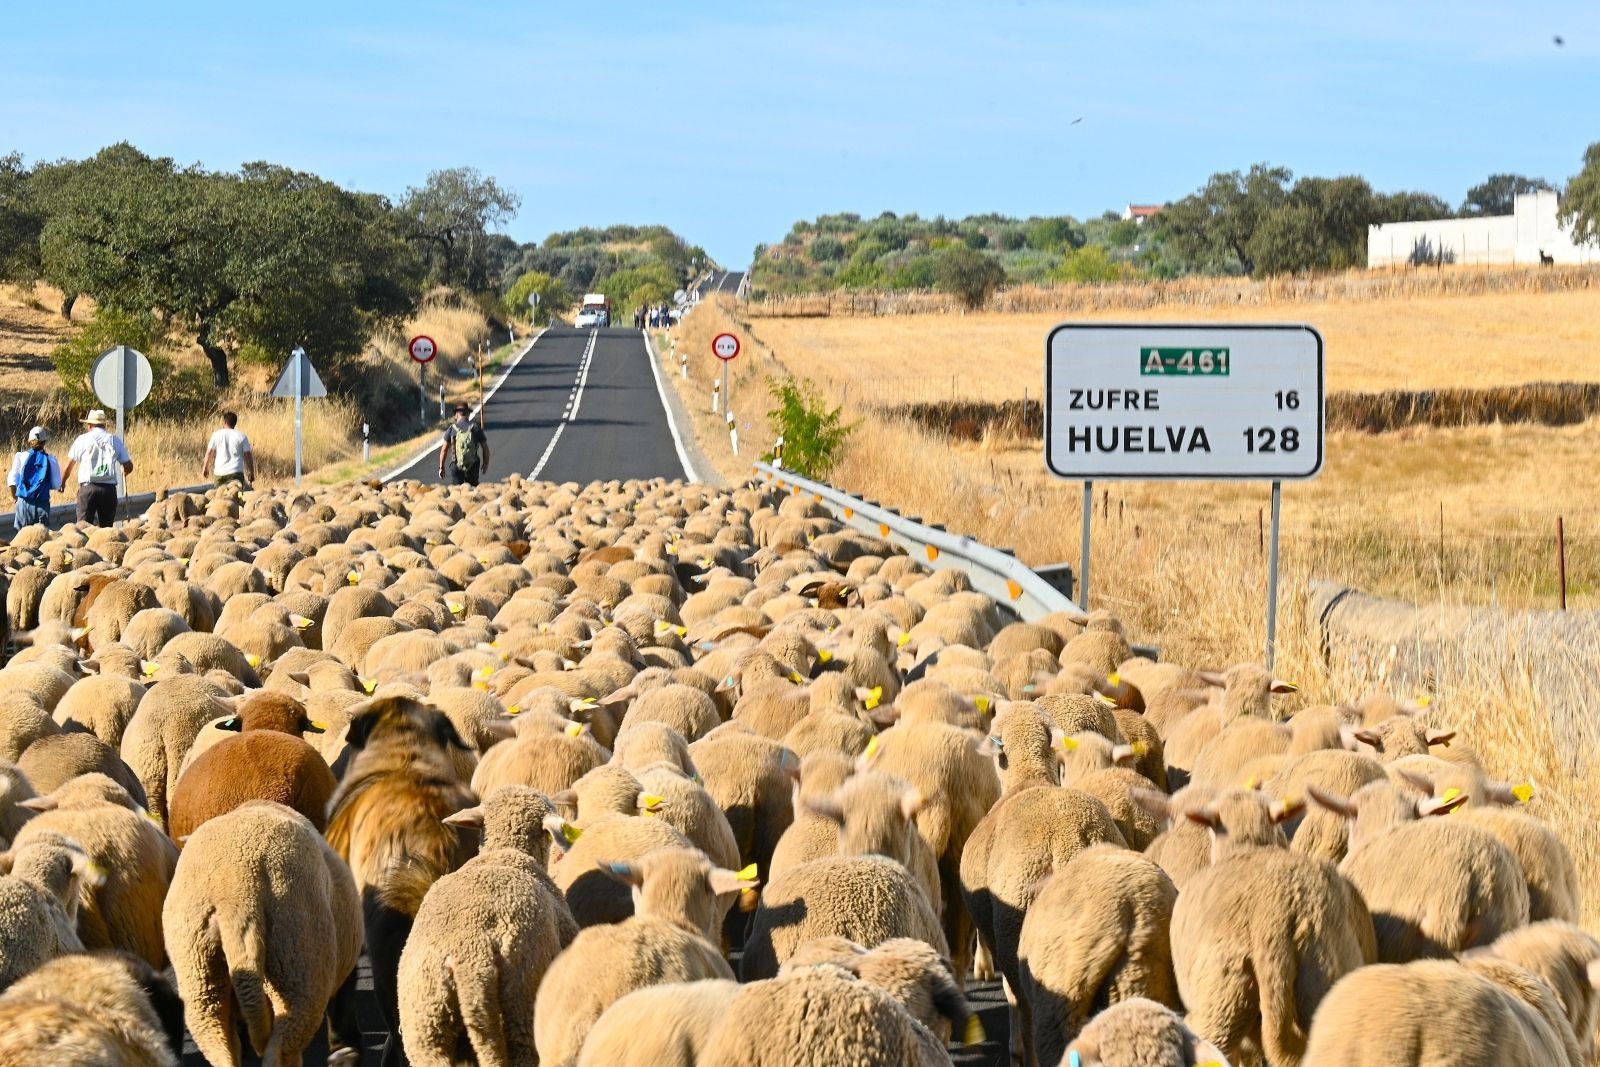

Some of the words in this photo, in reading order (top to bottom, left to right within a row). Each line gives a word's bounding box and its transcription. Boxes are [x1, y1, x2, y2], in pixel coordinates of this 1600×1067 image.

[1144, 350, 1227, 374] A-461
[1069, 389, 1160, 410] ZUFRE
[1275, 389, 1300, 410] 16
[1068, 426, 1211, 453] HUELVA
[1243, 426, 1300, 453] 128
